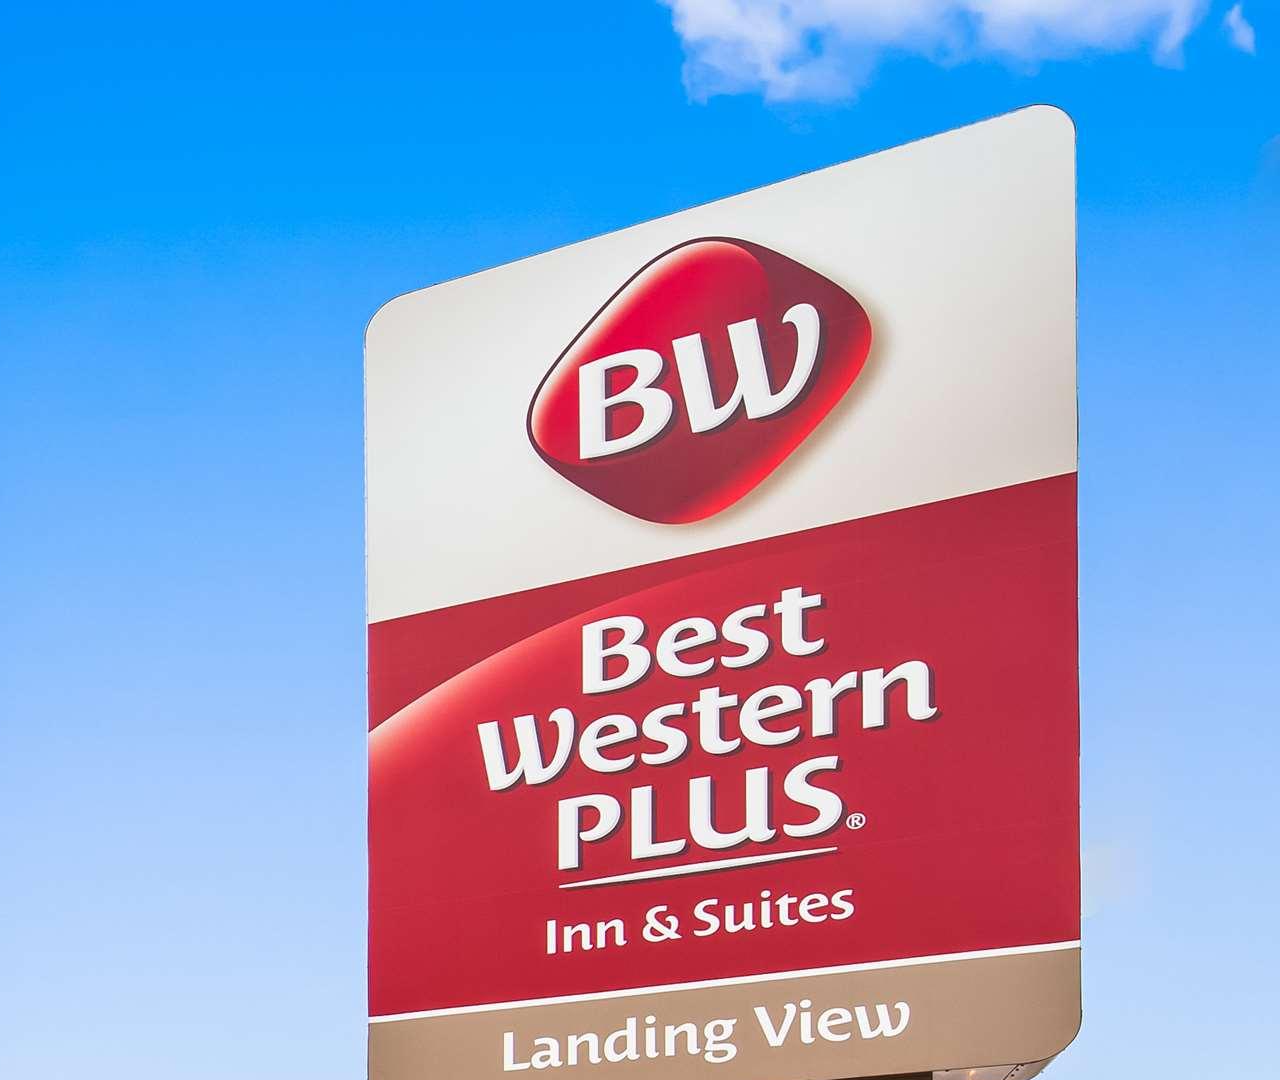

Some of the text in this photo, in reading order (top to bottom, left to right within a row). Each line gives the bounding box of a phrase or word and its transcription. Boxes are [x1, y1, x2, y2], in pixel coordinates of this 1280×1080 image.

[578, 303, 820, 460] BW
[582, 587, 825, 694] Best
[477, 660, 938, 791] Western
[546, 889, 855, 954] Inn & Suites
[503, 999, 911, 1072] Landing View
